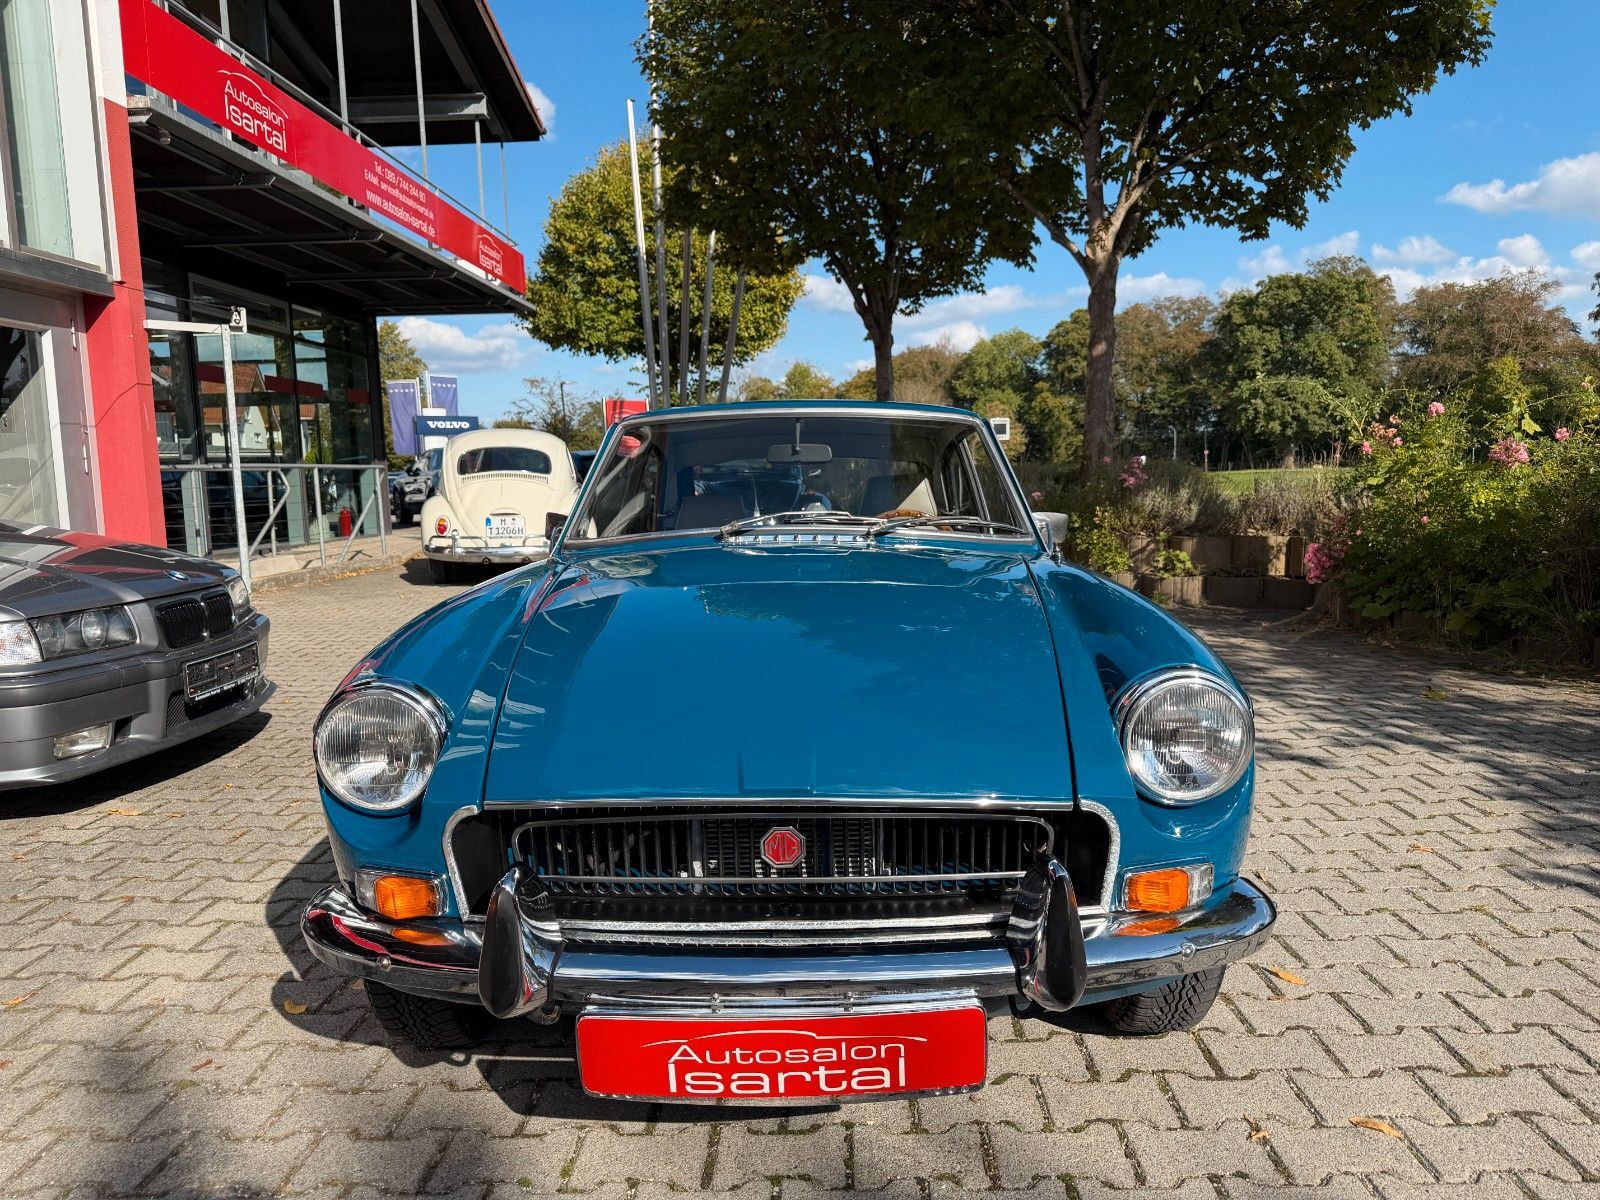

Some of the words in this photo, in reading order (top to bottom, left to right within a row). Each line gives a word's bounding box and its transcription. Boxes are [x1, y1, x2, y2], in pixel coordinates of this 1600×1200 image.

[224, 79, 286, 129] Autosalon
[224, 93, 287, 153] Isartal
[384, 167, 396, 184] 089
[399, 177, 409, 192] 744
[365, 188, 436, 238] www.autosalon-isartal.de
[479, 240, 503, 261] Autosalon
[479, 247, 503, 276] Isartal
[427, 420, 470, 429] VOLVO
[768, 833, 798, 861] MG
[668, 1042, 905, 1065] Autosalon
[668, 1057, 906, 1094] Isartal
